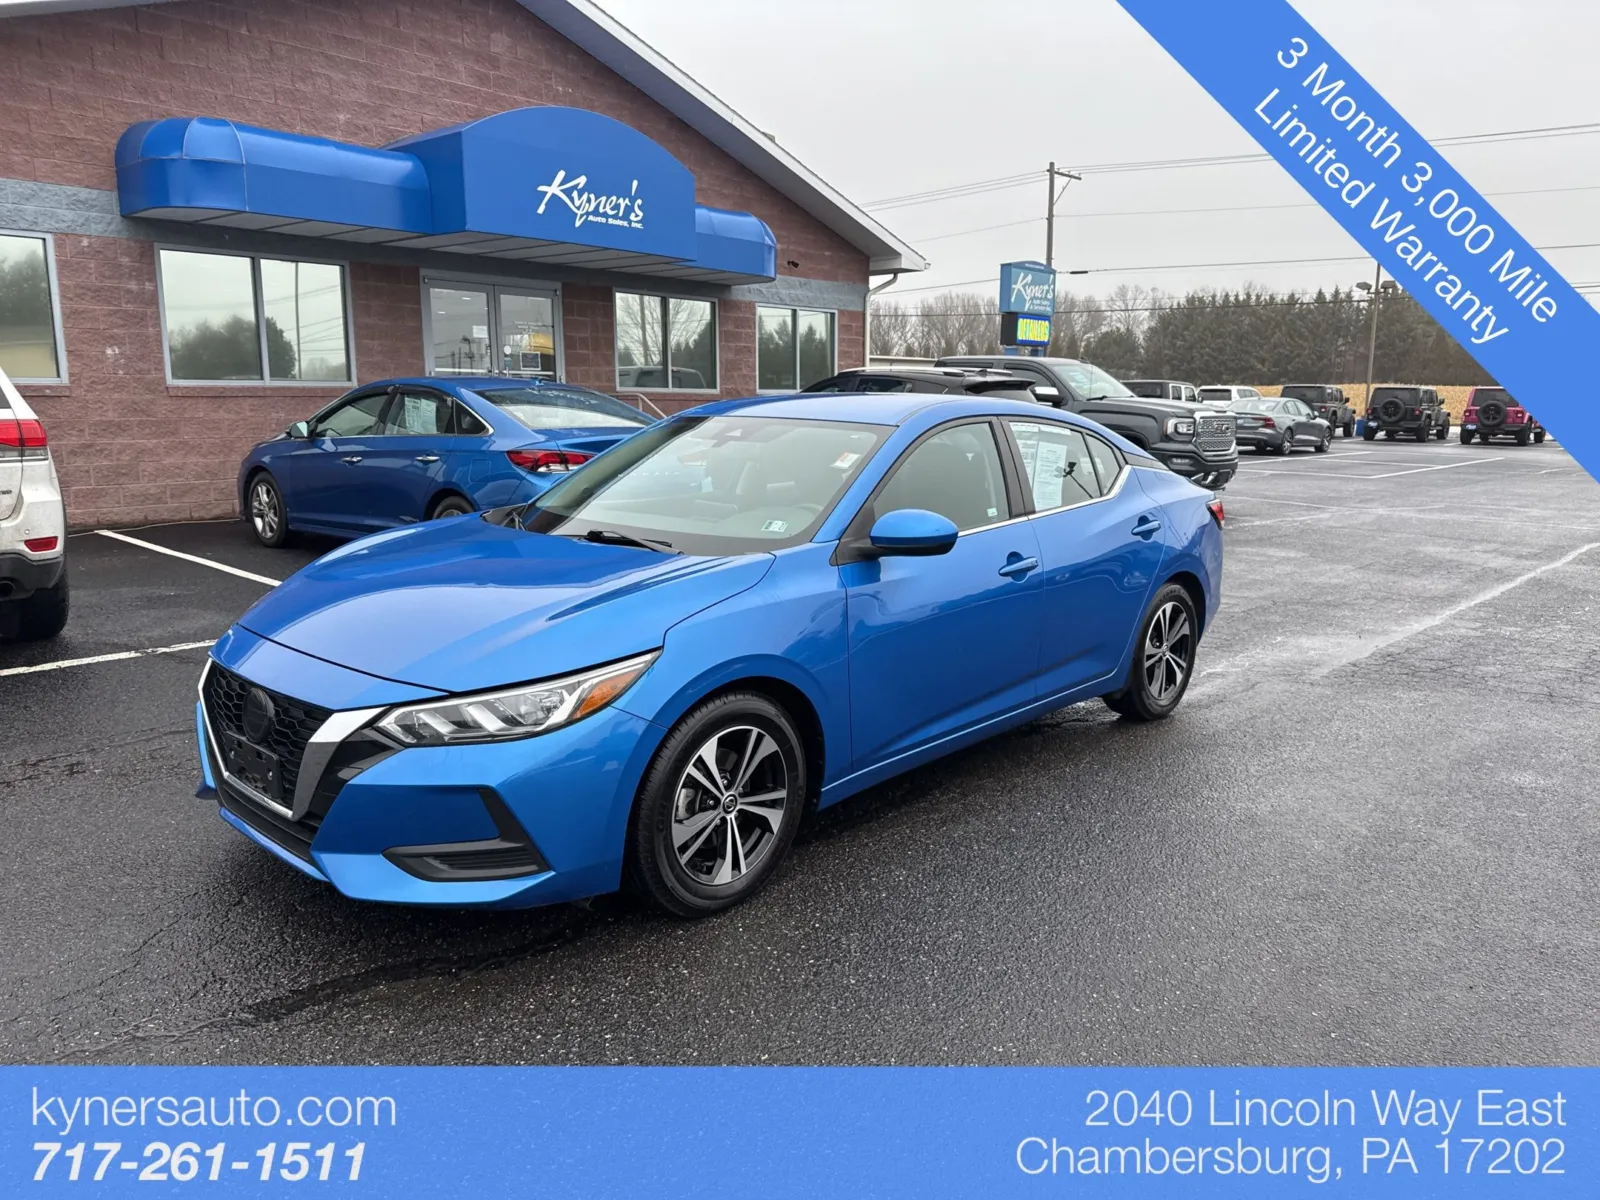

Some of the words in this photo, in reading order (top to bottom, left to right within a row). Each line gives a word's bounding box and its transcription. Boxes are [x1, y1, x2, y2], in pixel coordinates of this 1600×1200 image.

[537, 169, 643, 229] Kyner's
[588, 215, 606, 224] Auto
[1011, 272, 1053, 312] Kyner's
